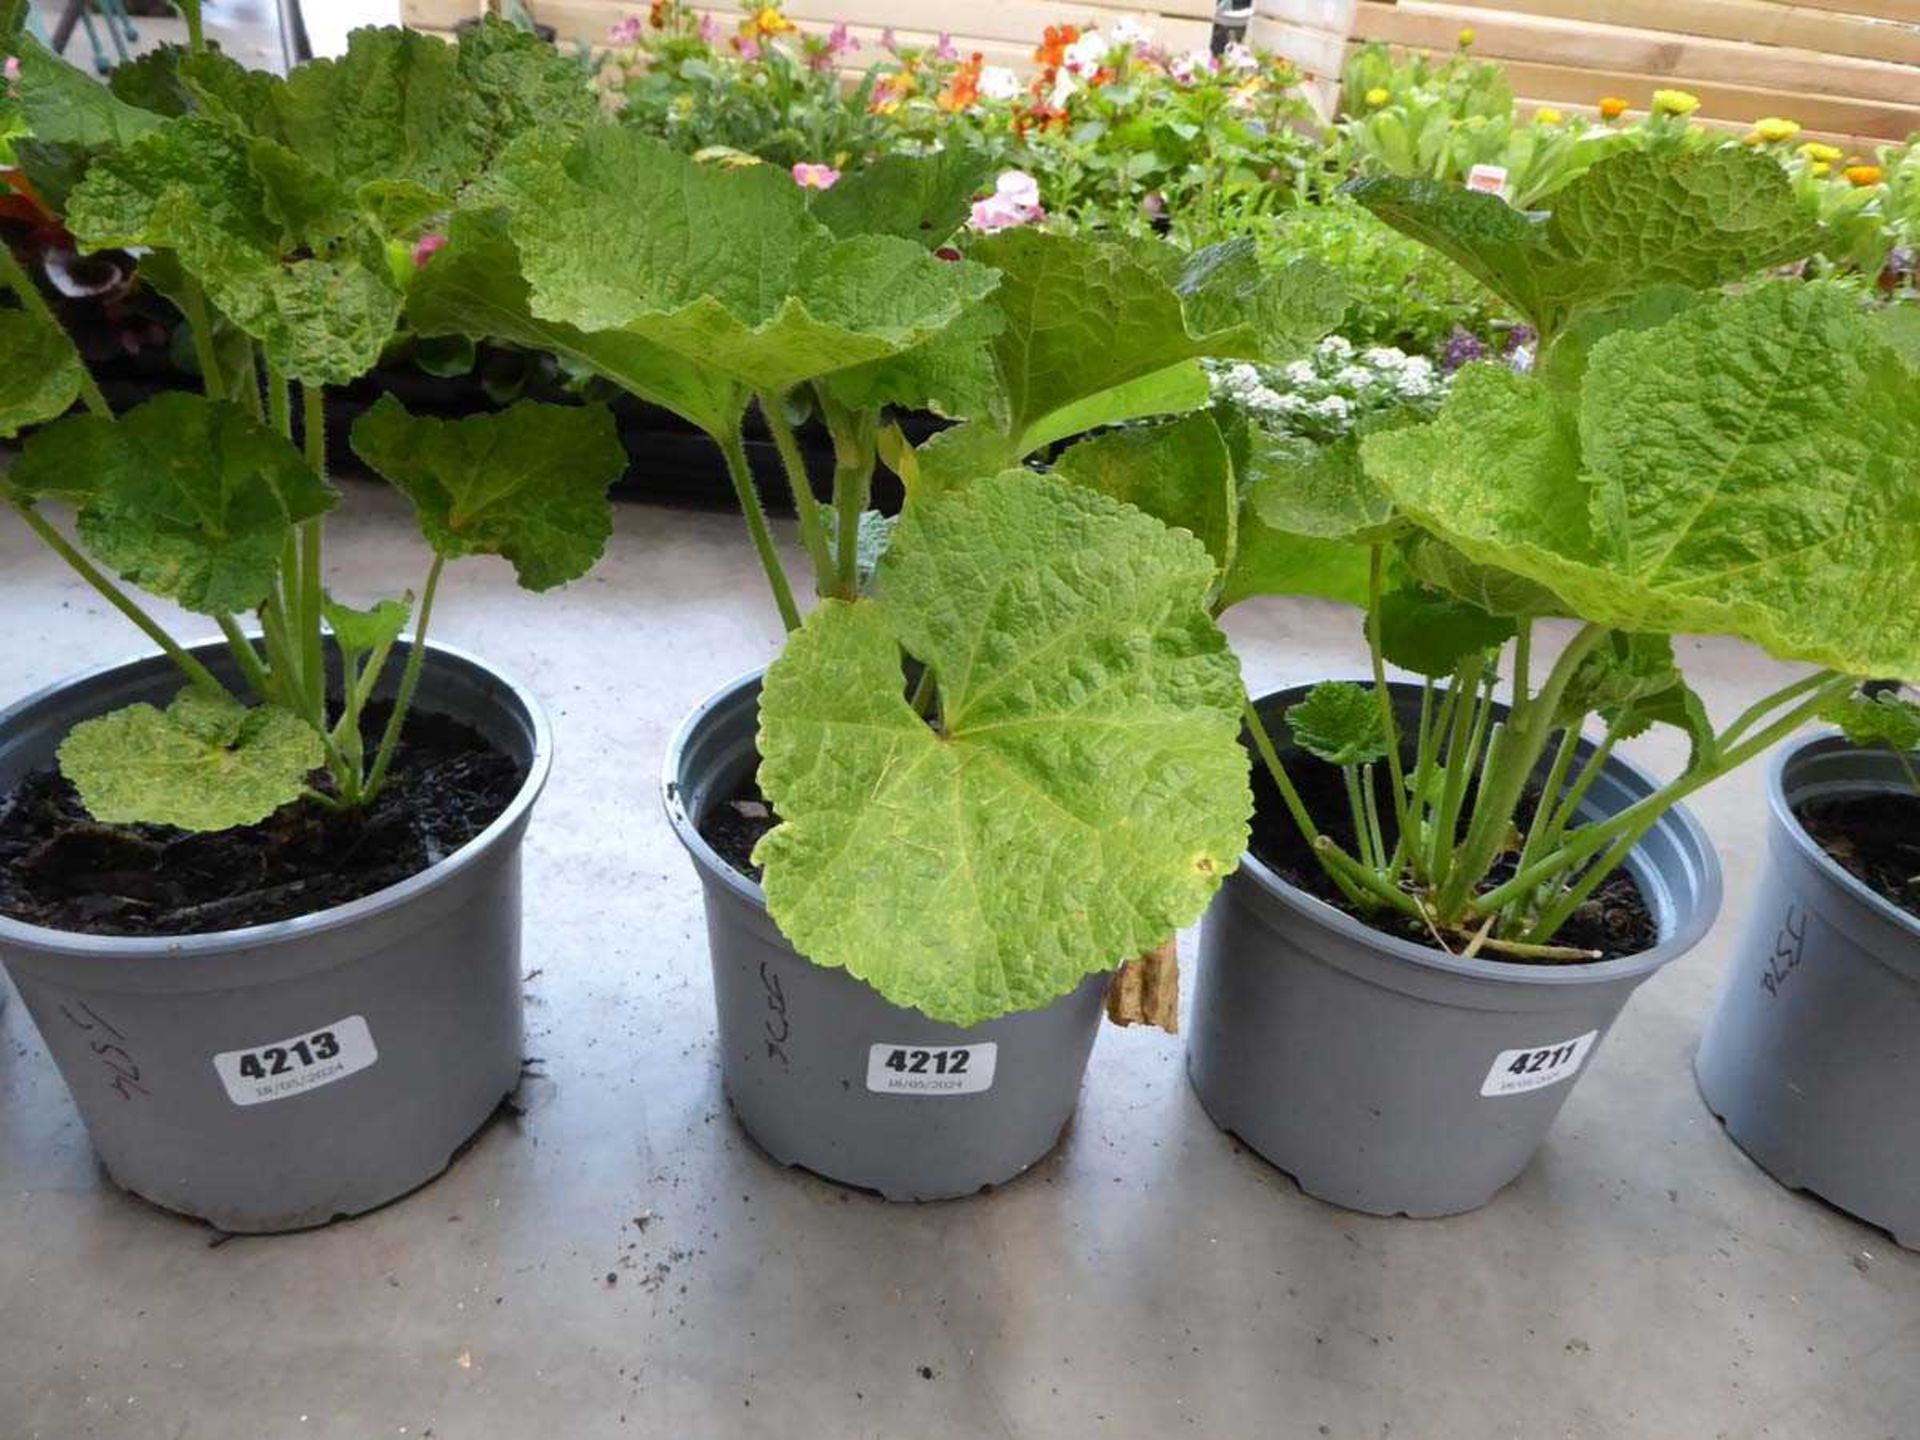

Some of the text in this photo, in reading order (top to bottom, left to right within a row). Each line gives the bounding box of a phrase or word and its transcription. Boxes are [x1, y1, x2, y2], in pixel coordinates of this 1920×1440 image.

[240, 1032, 340, 1079] 4213
[885, 1049, 970, 1074] 4212
[1508, 1042, 1577, 1074] 4211
